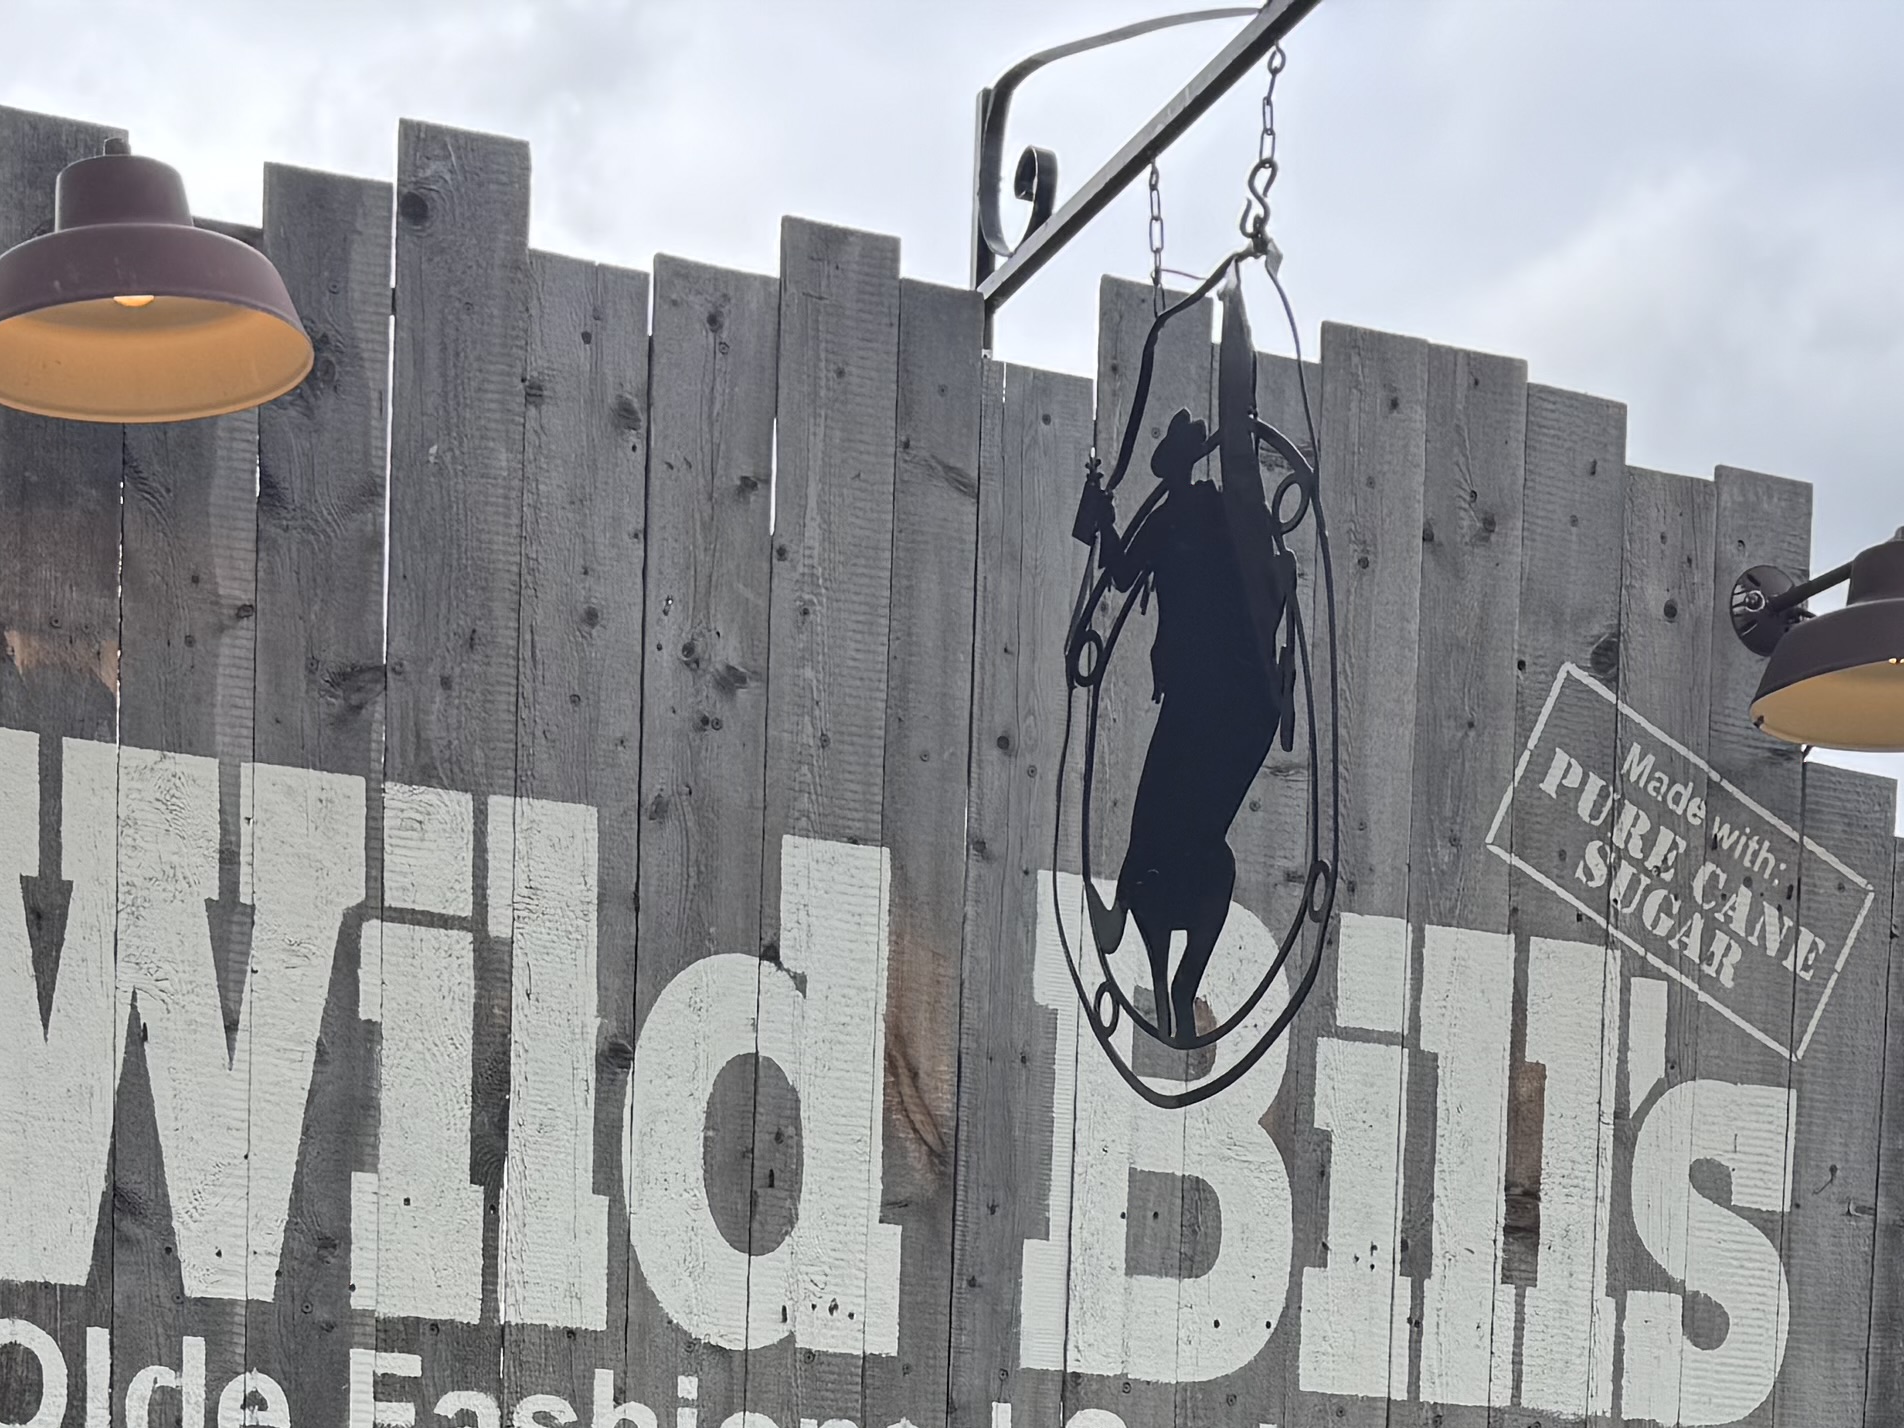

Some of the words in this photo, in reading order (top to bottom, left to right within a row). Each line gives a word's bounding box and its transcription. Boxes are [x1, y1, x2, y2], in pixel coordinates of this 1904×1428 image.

[1539, 747, 1686, 881] PURE
[1692, 861, 1825, 981] CANE
[1620, 742, 1707, 825] Made
[1713, 815, 1787, 886] with:
[1575, 839, 1743, 989] SUGAR
[1021, 870, 1796, 1426] Bill's
